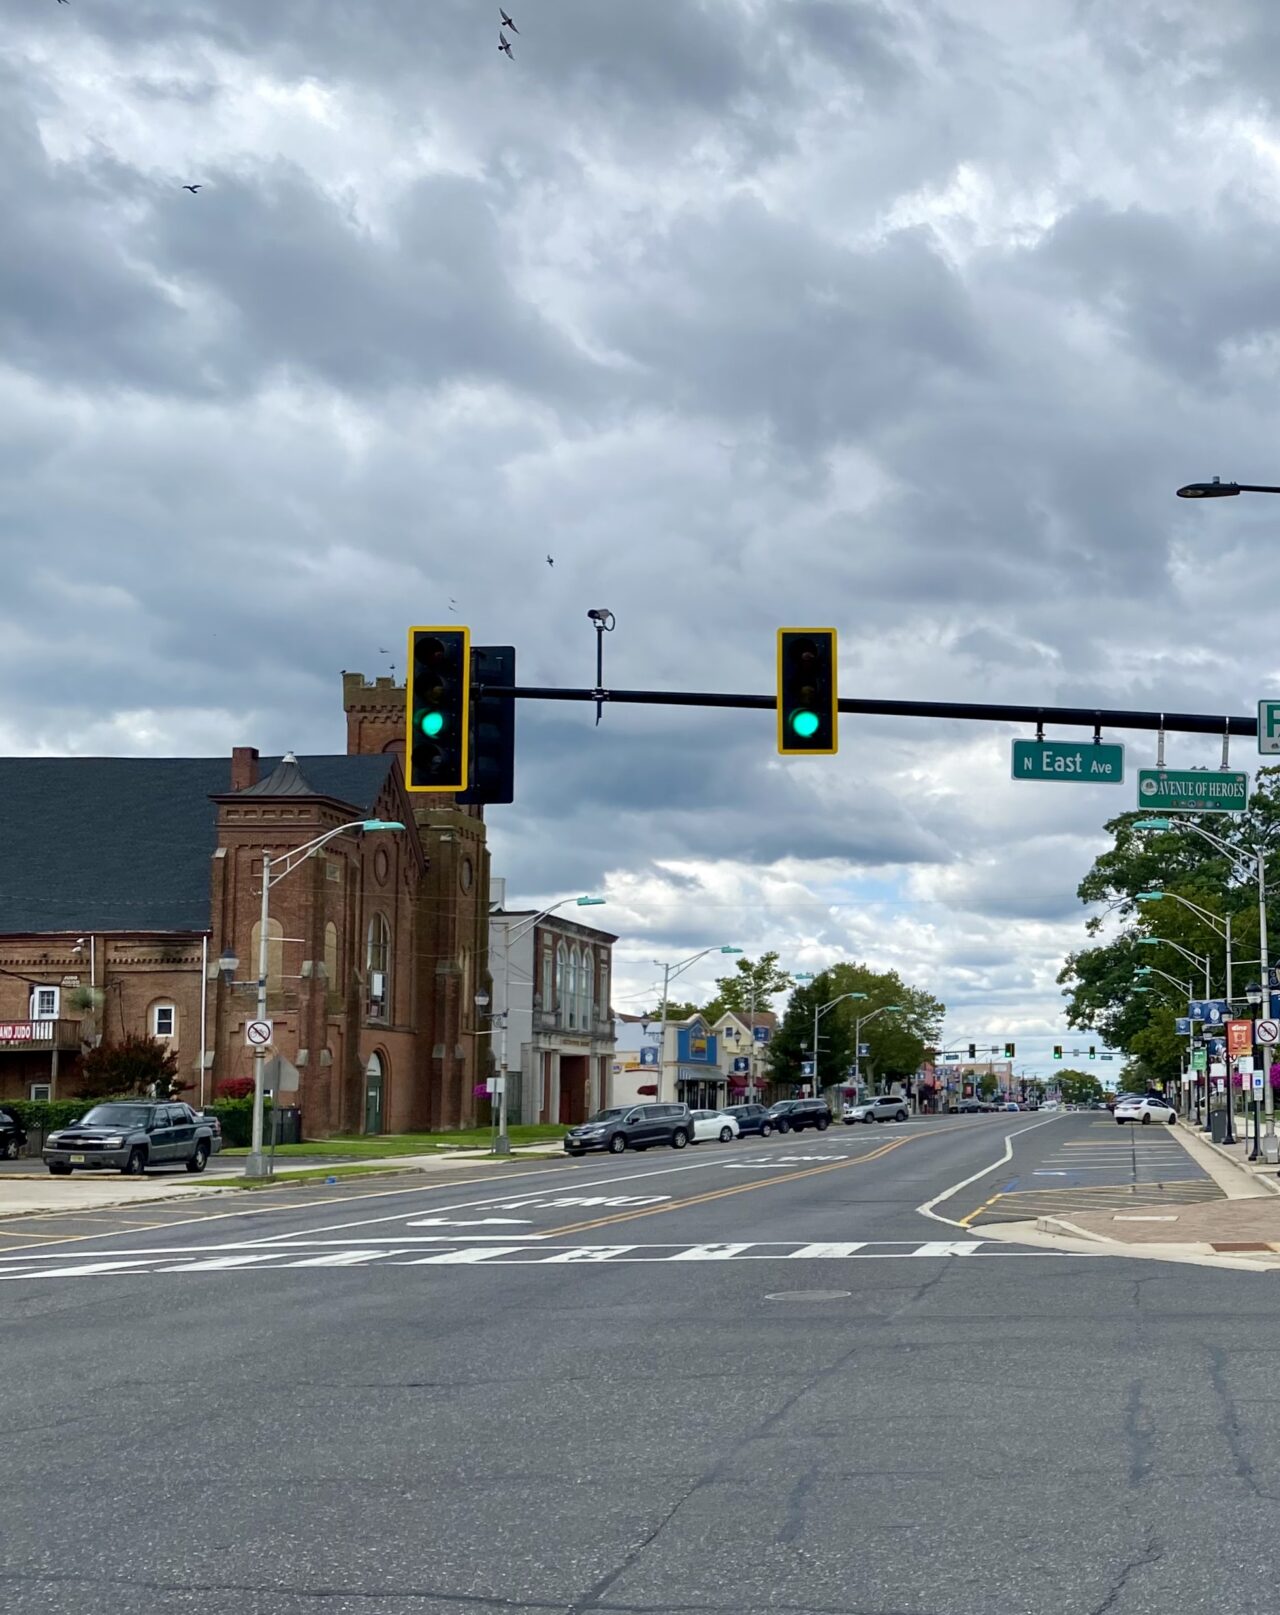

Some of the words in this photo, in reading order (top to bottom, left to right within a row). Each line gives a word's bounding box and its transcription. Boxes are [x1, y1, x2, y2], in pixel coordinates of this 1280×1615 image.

[1023, 757, 1033, 770] N
[1042, 751, 1082, 773] East
[1090, 761, 1112, 774] Ave
[1158, 780, 1195, 796] AVENUE
[1195, 783, 1208, 797] OF
[1209, 783, 1244, 797] HEROES
[13, 1026, 31, 1039] JUDO
